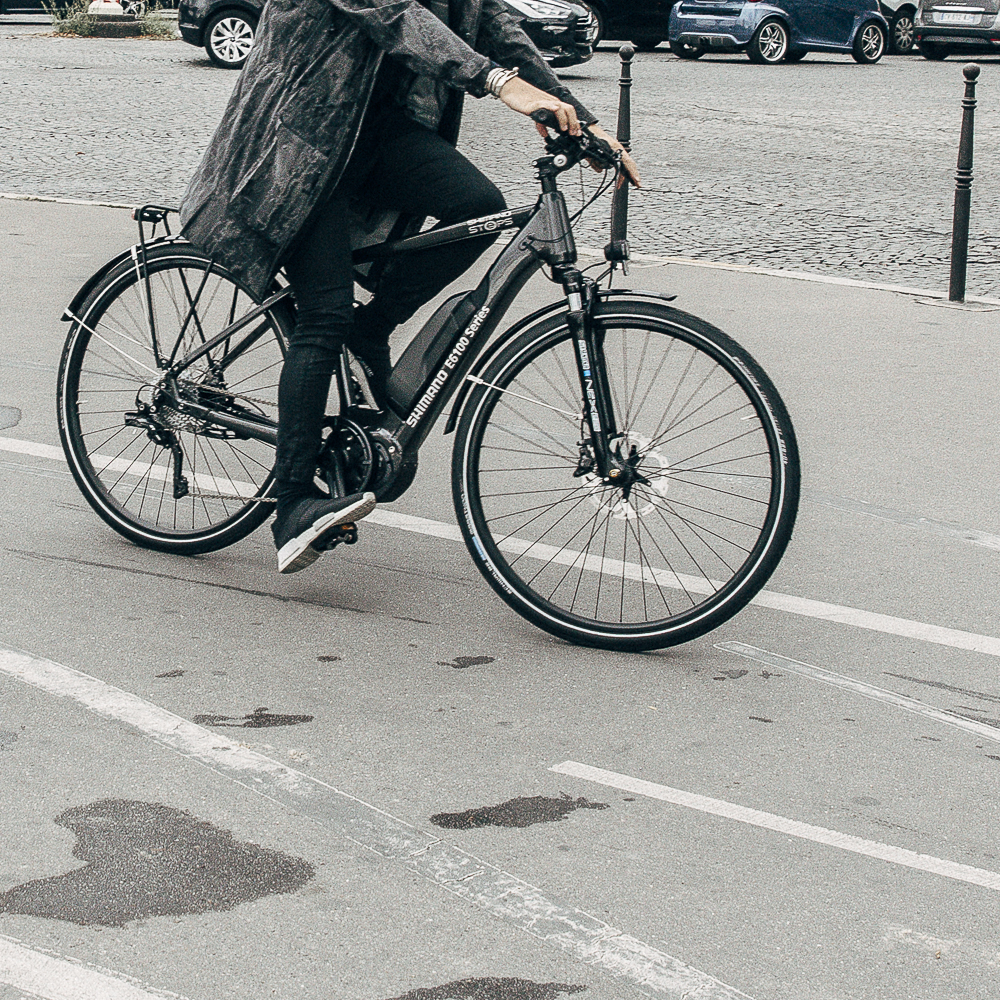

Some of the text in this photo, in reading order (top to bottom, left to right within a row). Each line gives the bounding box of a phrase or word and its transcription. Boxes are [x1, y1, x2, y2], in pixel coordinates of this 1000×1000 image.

[406, 305, 491, 428] SHIMANO E6100 Series
